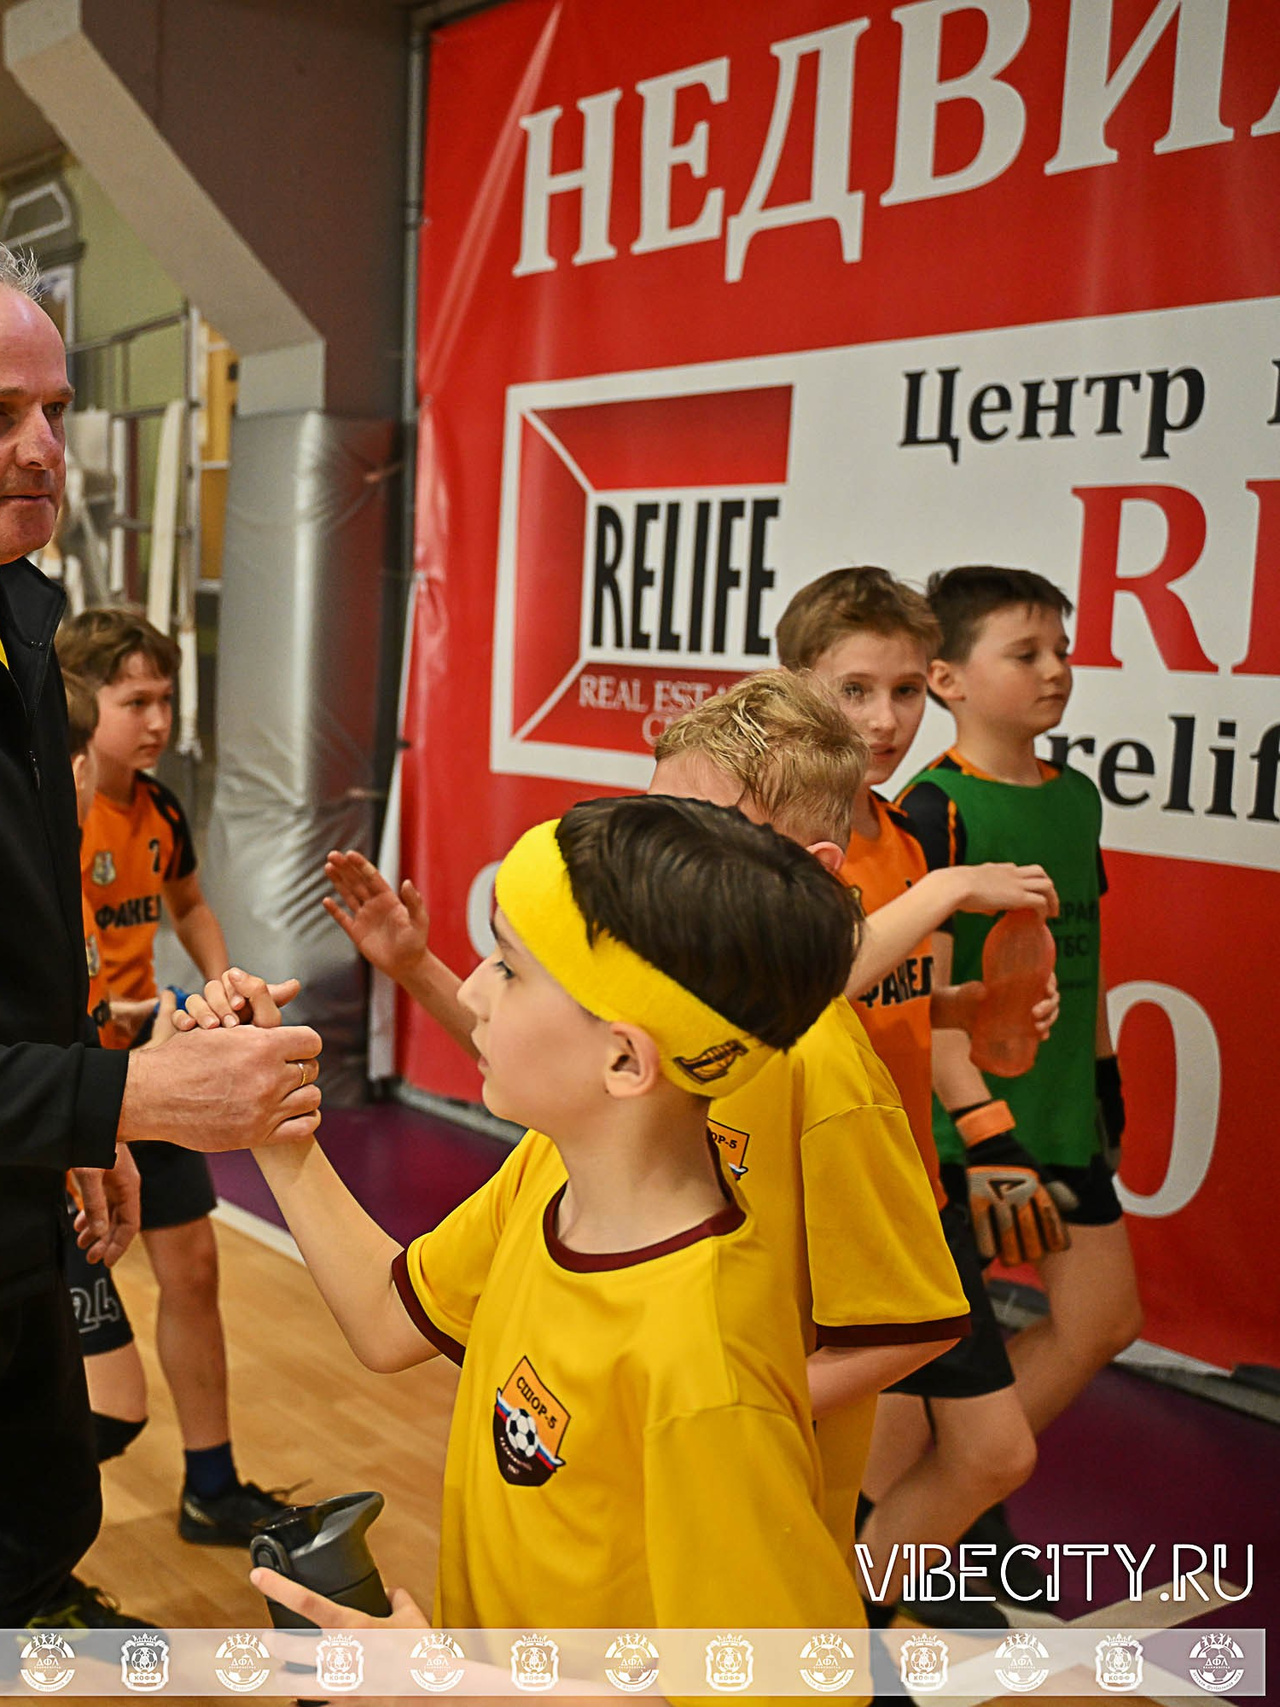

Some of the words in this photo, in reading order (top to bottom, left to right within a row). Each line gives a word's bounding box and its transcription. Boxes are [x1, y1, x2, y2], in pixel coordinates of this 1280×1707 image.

[512, 0, 1280, 283] НЕДВИ
[898, 364, 1205, 464] Центр
[592, 497, 780, 657] RELIFE
[579, 674, 648, 712] REAL
[653, 680, 732, 712] EST
[70, 1278, 120, 1333] 24
[516, 1376, 557, 1429] СШОР-5
